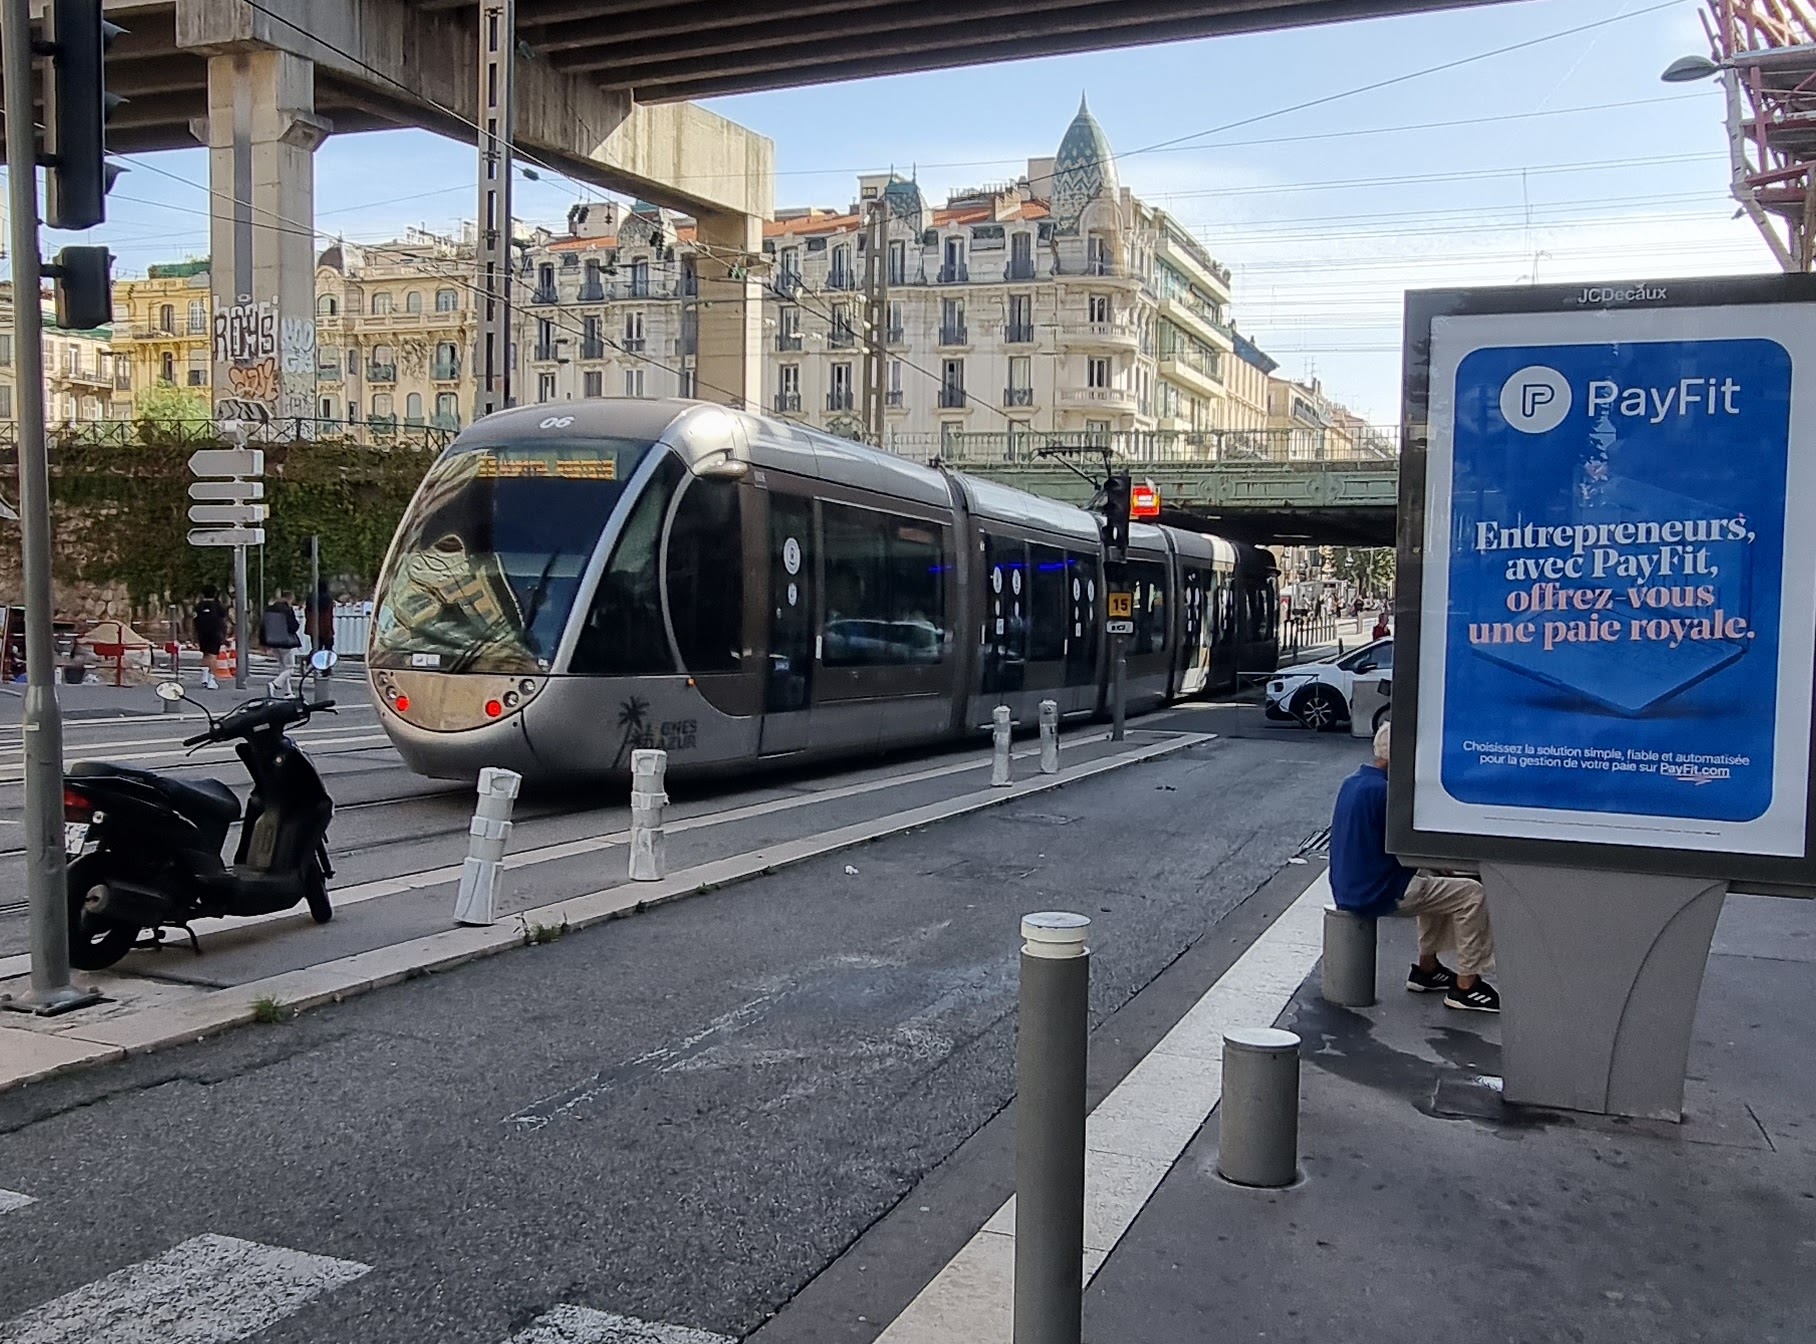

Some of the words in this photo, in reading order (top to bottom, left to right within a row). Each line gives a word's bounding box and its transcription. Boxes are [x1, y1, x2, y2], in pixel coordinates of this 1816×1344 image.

[1577, 286, 1668, 304] JCDecaux
[1588, 377, 1741, 424] PayFit
[539, 416, 575, 429] 06
[1475, 516, 1756, 556] Entrepreneurs,
[1505, 557, 1583, 581] avec
[1591, 545, 1719, 585] PayFit,
[1112, 598, 1128, 612] 15
[1506, 582, 1715, 613] offrez-vous
[1468, 621, 1534, 645] une
[1543, 613, 1621, 651] paie
[1630, 609, 1756, 649] royale.
[1463, 740, 1523, 755] Choisissez
[1525, 744, 1535, 754] la
[1537, 745, 1581, 757] solution
[1584, 747, 1624, 761] simple,
[1627, 749, 1659, 761] fiable
[1661, 751, 1673, 762] et
[1675, 753, 1750, 766] automatisée
[1480, 754, 1505, 765] pour
[1508, 754, 1517, 765] la
[1519, 756, 1561, 768] gestion
[1563, 757, 1578, 768] de
[1581, 759, 1609, 770] votre
[1612, 760, 1637, 772] paie
[1639, 763, 1658, 772] sur
[1660, 762, 1730, 777] PayFit.com
